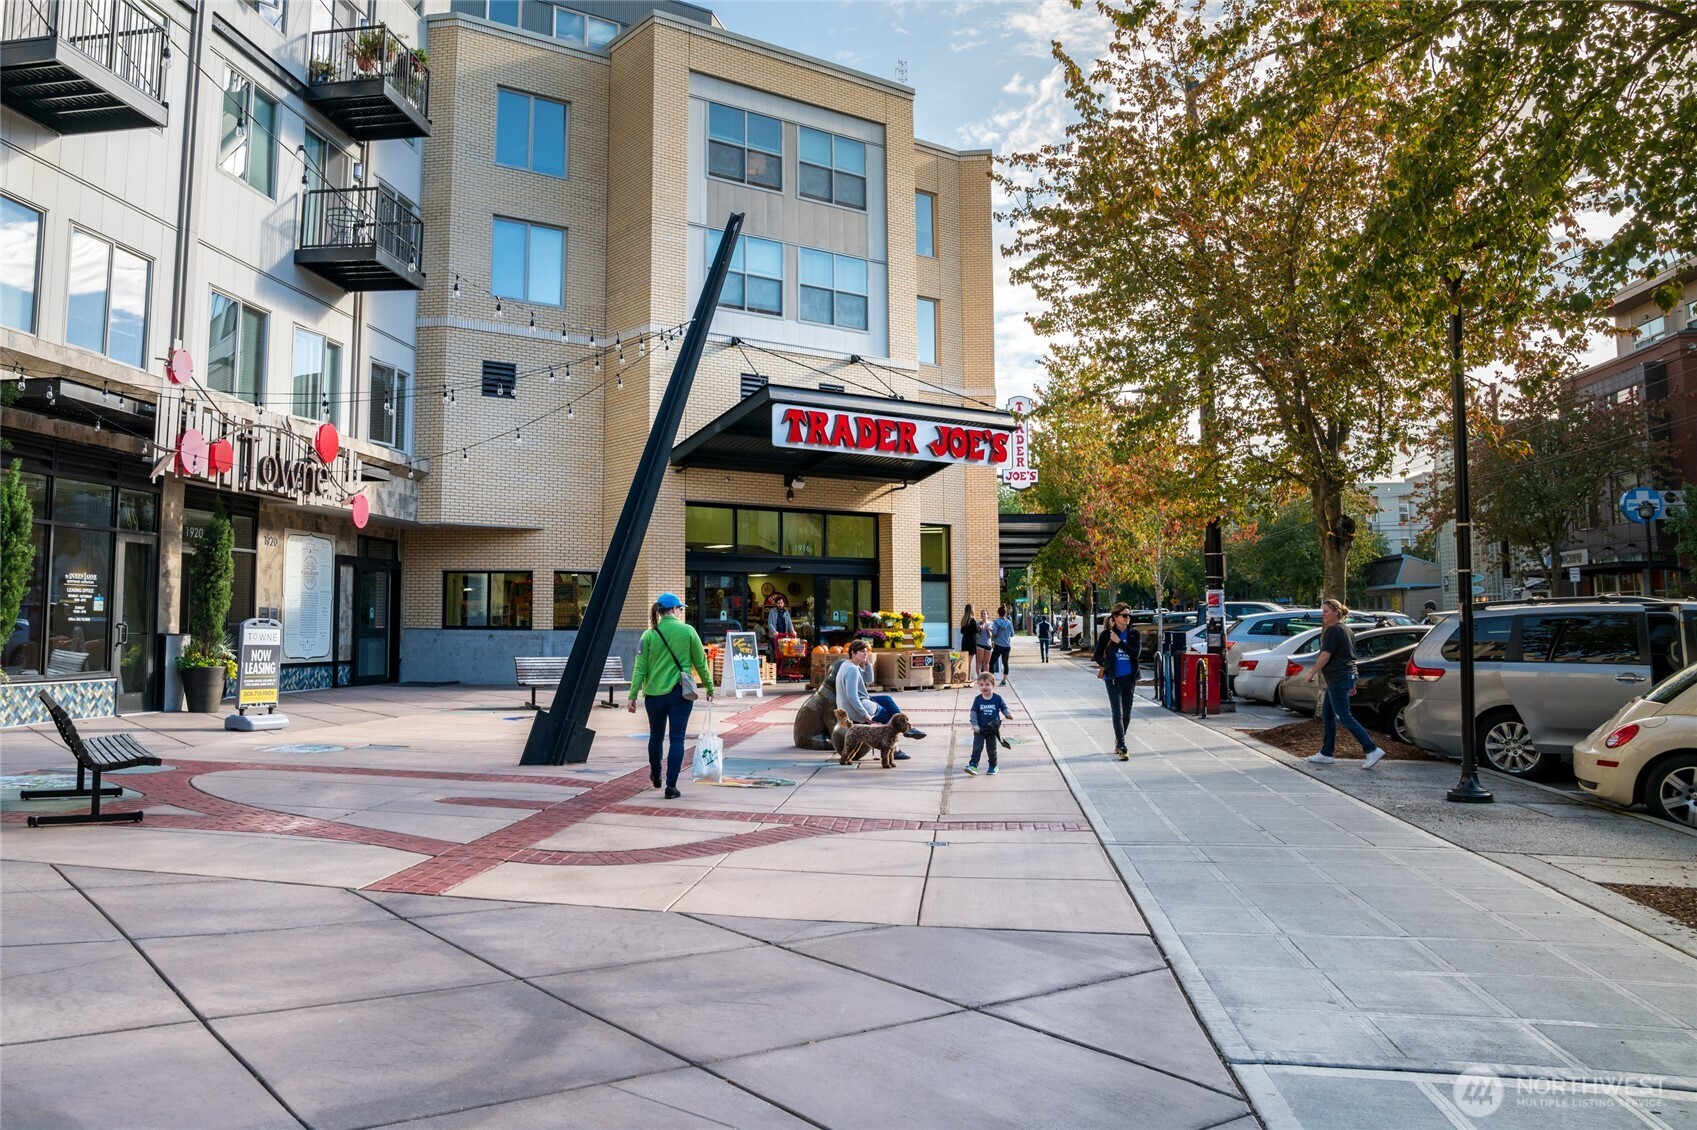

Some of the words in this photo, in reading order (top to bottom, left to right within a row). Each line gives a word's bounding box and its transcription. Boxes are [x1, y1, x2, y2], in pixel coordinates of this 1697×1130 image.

[782, 408, 919, 454] TRADER
[926, 425, 1010, 464] JOE'S
[1015, 401, 1025, 467] TADER
[242, 433, 329, 495] Towne
[1005, 471, 1037, 481] JOE'S
[185, 526, 204, 539] 1920
[264, 535, 278, 547] 1920
[794, 544, 811, 552] 1916
[248, 632, 277, 641] TOWNE
[251, 649, 272, 662] NOW
[244, 661, 276, 675] LEASING
